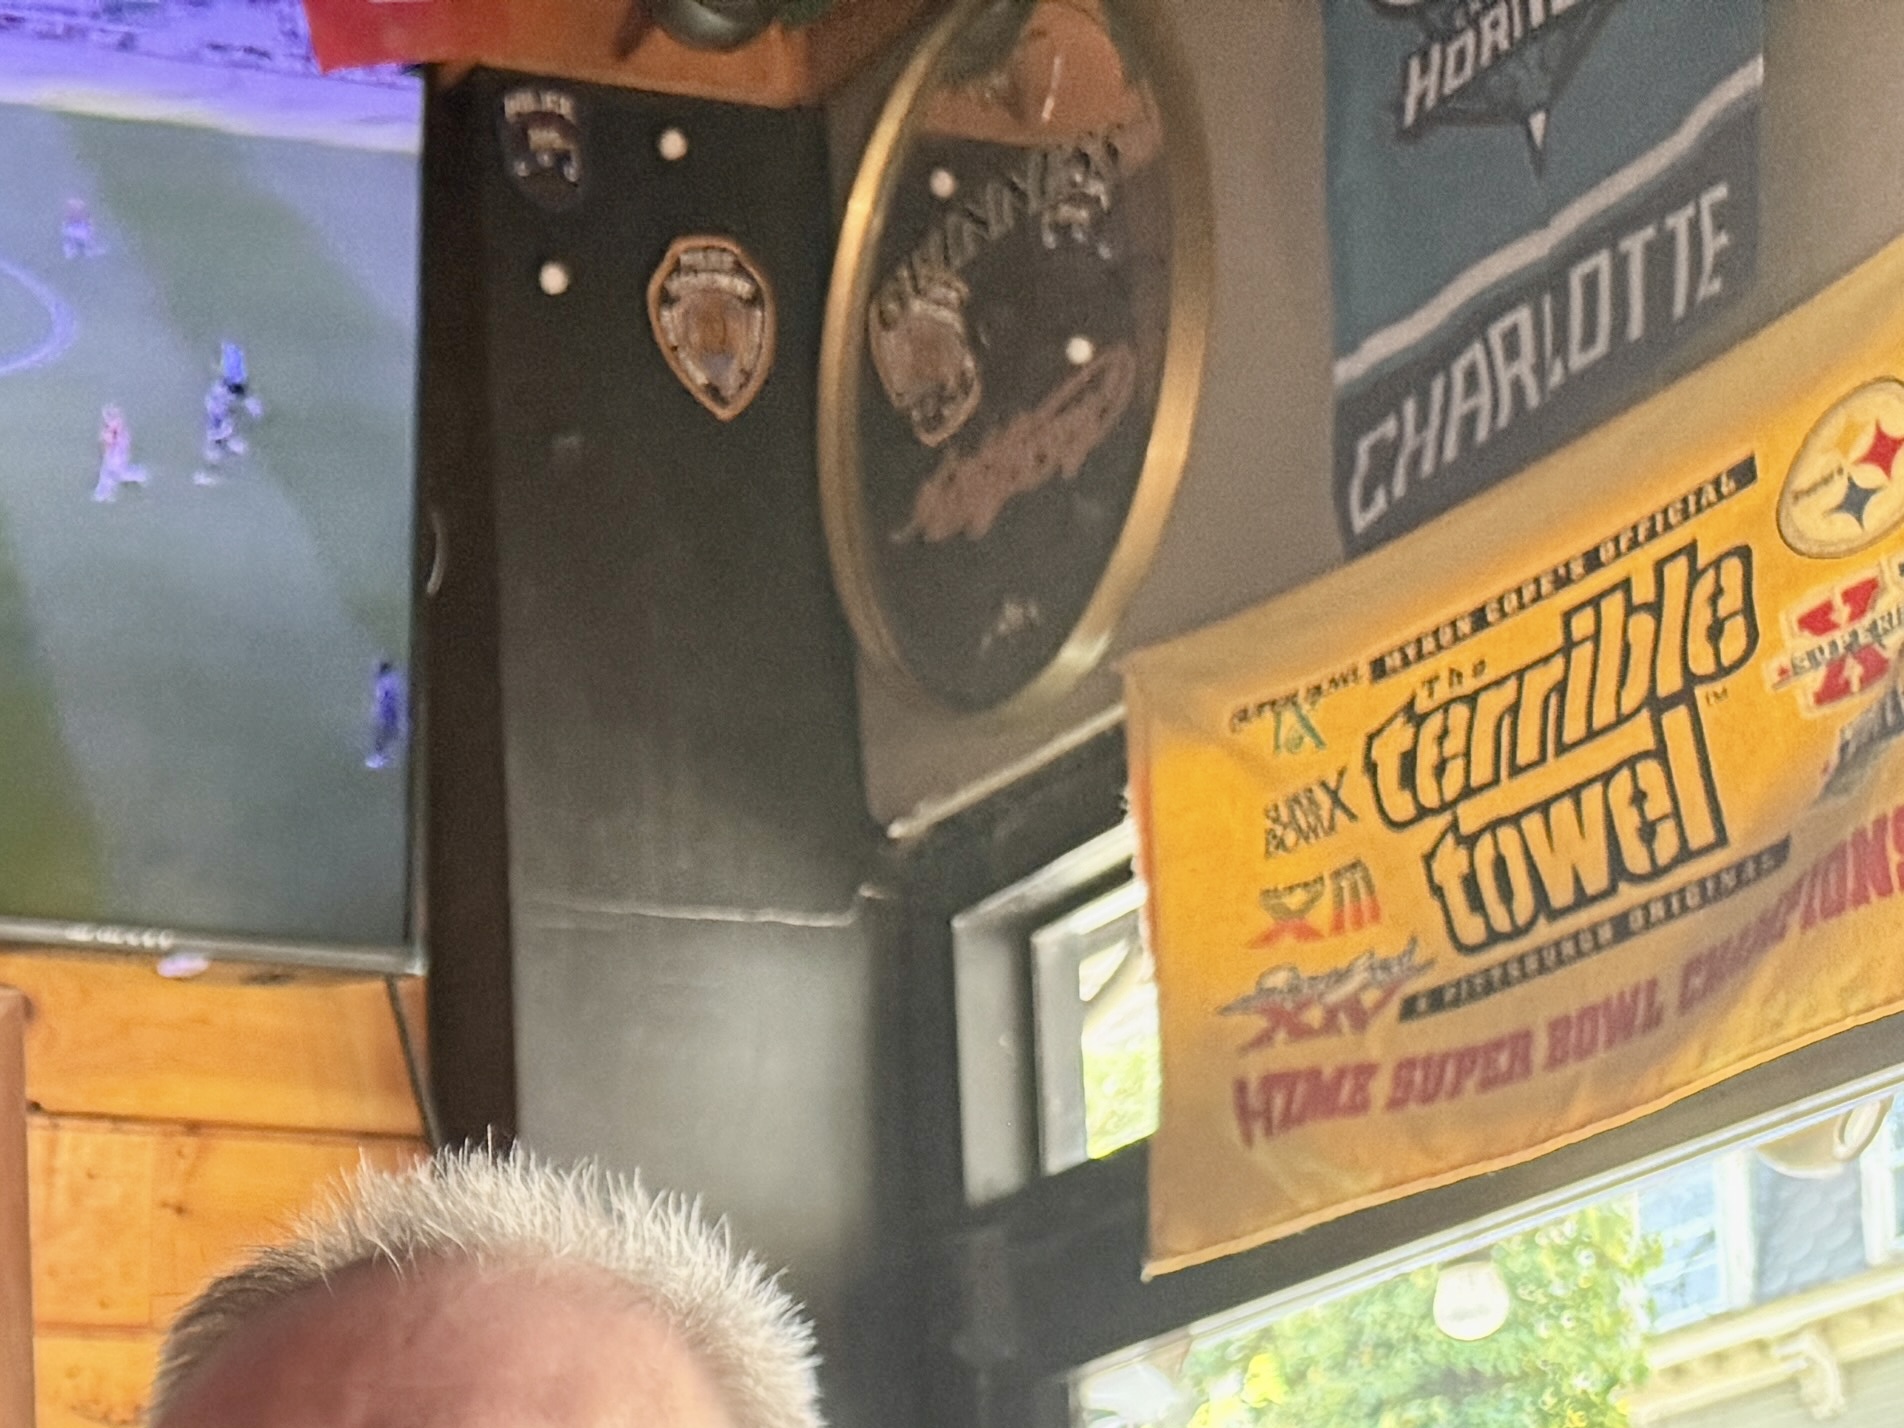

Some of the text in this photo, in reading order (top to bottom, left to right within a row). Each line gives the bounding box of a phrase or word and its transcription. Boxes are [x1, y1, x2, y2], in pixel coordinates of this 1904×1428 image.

[1349, 184, 1730, 535] CHARLOTTE
[1598, 472, 1737, 564] OFFICIAL
[1363, 537, 1759, 832] terrible
[1422, 657, 1487, 698] The
[1421, 700, 1730, 958] towel
[1629, 853, 1775, 935] ORIGINAL
[1386, 1028, 1533, 1112] SUPER
[1543, 977, 1664, 1074] BOWL
